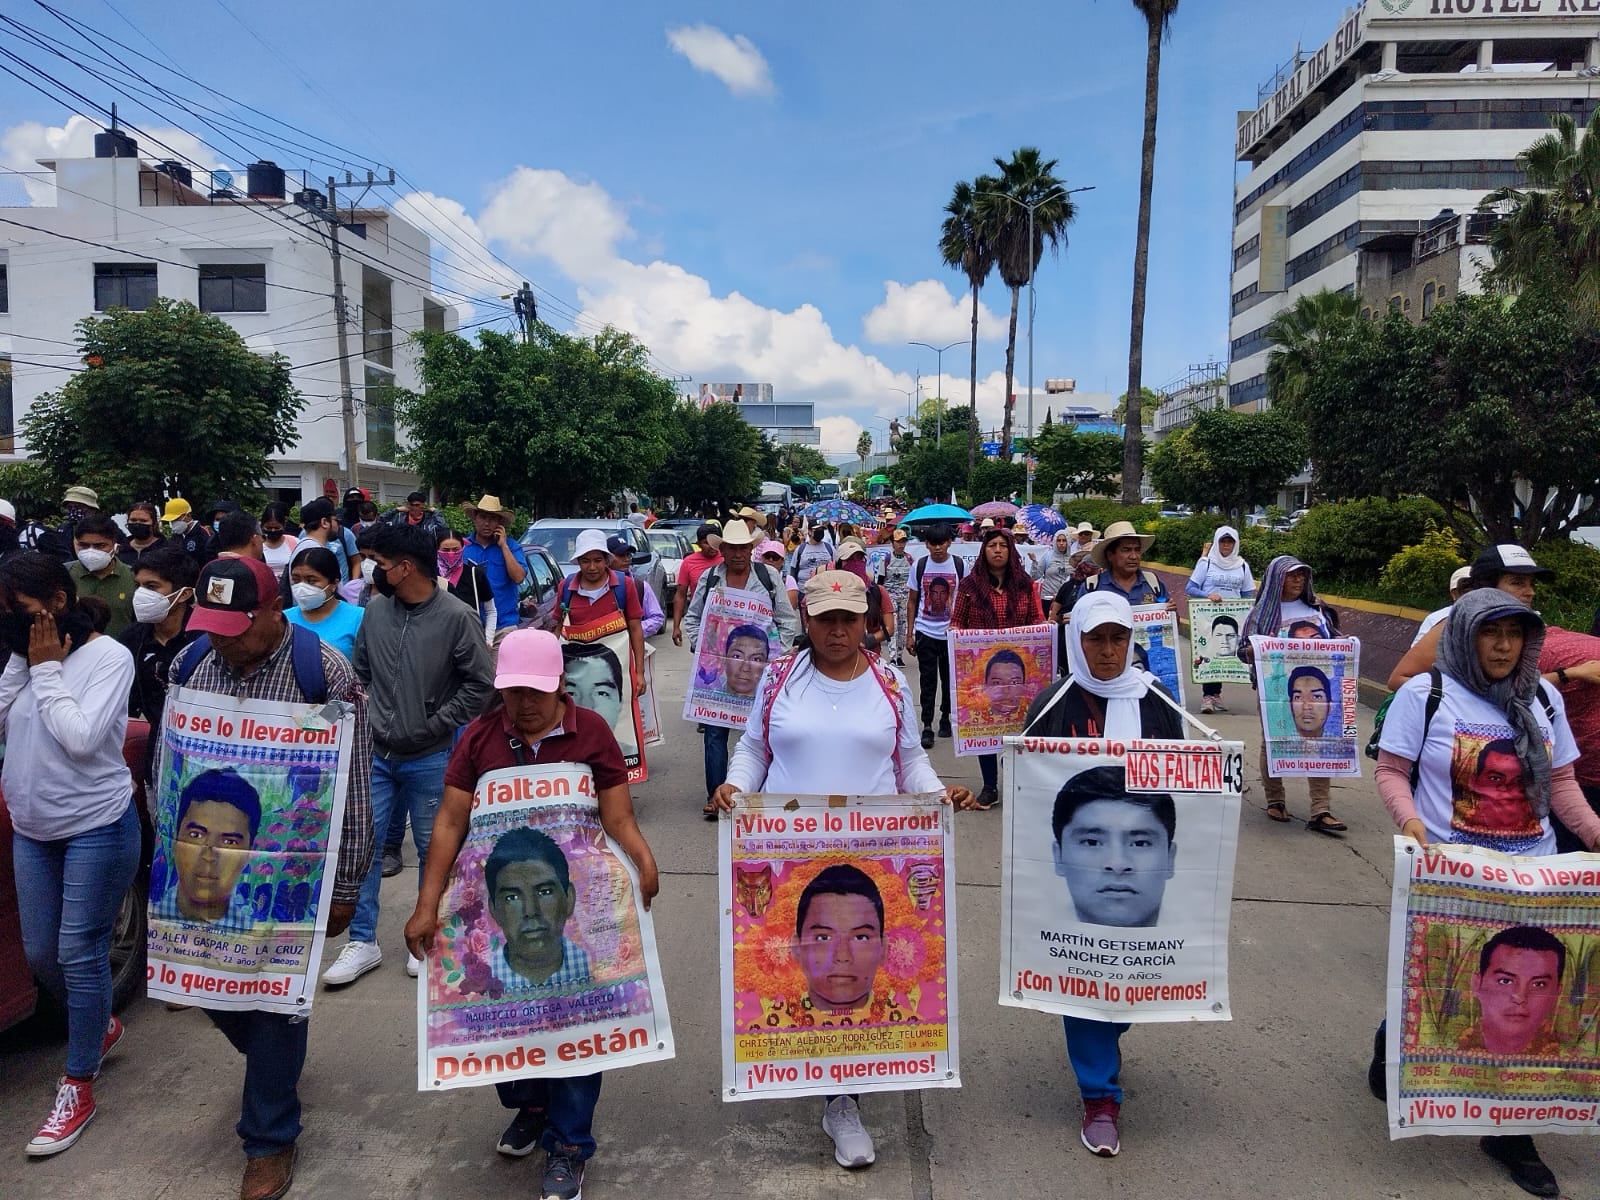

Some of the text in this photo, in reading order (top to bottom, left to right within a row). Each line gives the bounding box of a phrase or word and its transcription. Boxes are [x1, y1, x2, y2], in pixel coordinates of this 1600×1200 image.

[1307, 42, 1330, 89] DEL
[733, 600, 745, 608] se
[748, 601, 757, 611] lo
[1009, 624, 1050, 635] llevaron!
[1261, 641, 1285, 652] ¡Vivo
[1302, 642, 1311, 651] lo
[1314, 643, 1354, 652] llevaron!
[1343, 678, 1356, 695] NOS
[694, 706, 748, 724] ¡Vivo lo que
[1343, 697, 1355, 725] FALTAN
[190, 715, 212, 733] se
[217, 715, 234, 737] lo
[240, 718, 338, 745] llevaron!
[964, 738, 998, 750] ¡Vivo lo
[1077, 741, 1100, 755] se
[1106, 739, 1125, 757] lo
[1127, 752, 1243, 793] NOS FALTAN 43
[1277, 760, 1295, 771] ¡Vivo
[1304, 760, 1351, 771] queremos!
[487, 777, 570, 805] faltan
[735, 810, 939, 838] ¡Vivo se lo llevaron!
[1415, 853, 1474, 878] ¡Vivo
[1482, 865, 1508, 883] se
[1512, 868, 1534, 886] lo
[162, 932, 188, 944] ALEN
[193, 937, 229, 951] GASPAR
[234, 943, 248, 954] DE
[255, 945, 268, 955] LA
[275, 945, 305, 955] CRUZ
[1040, 930, 1185, 951] MARTÍN GETSEMANY
[165, 946, 170, 954] y
[223, 955, 233, 963] 22
[236, 958, 256, 966] años
[1049, 946, 1176, 967] SÁNCHEZ GARCÍA
[160, 964, 177, 984] lo
[181, 972, 292, 997] queremos!
[1067, 966, 1162, 980] EDAD 20 AÑOS
[1017, 969, 1207, 1006] ¡Con VIDA lo queremos!
[466, 993, 614, 1023] MAURICIO ORTEGA VALERIO
[739, 1038, 791, 1048] CHRISTIAN
[900, 1029, 944, 1039] TELUMBRE
[436, 1027, 648, 1080] Dónde están
[745, 1050, 763, 1059] Hijo
[747, 1054, 936, 1089] ¡Vivo lo queremos!
[1413, 1064, 1441, 1077] JOSÉ
[1448, 1065, 1488, 1080] ÁNGEL
[1499, 1070, 1547, 1082] CAMPOS
[1409, 1099, 1597, 1126] ¡Vivo lo queremos!
